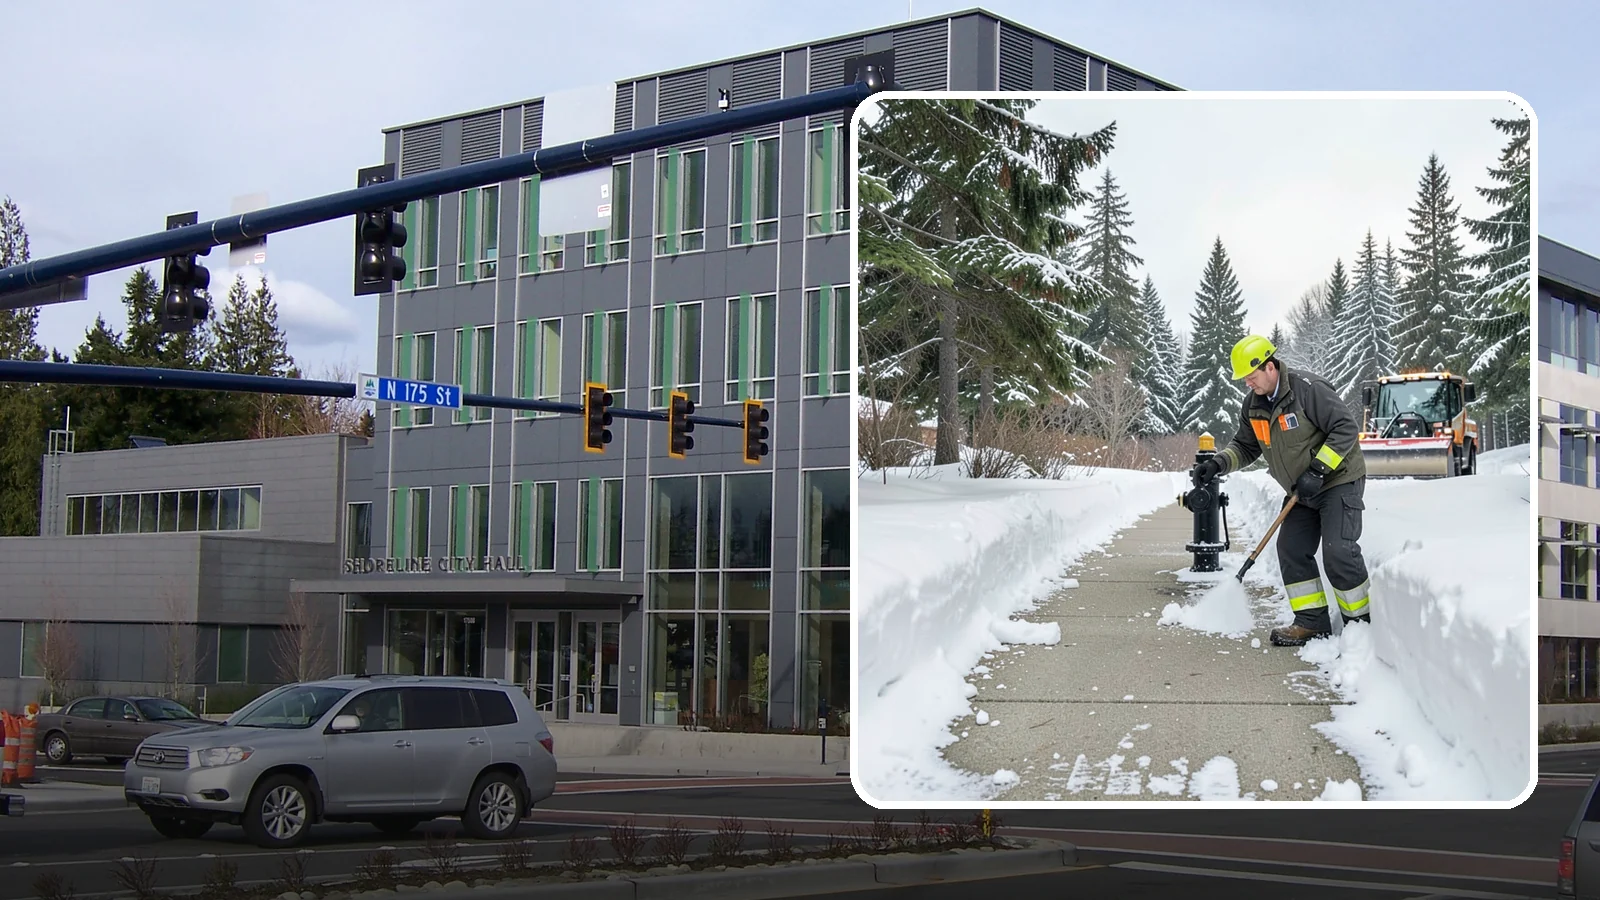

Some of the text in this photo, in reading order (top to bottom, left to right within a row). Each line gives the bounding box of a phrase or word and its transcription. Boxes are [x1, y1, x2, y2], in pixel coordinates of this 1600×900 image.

[387, 380, 451, 406] N 175 St
[344, 555, 525, 574] SHORELINE CITY HALL
